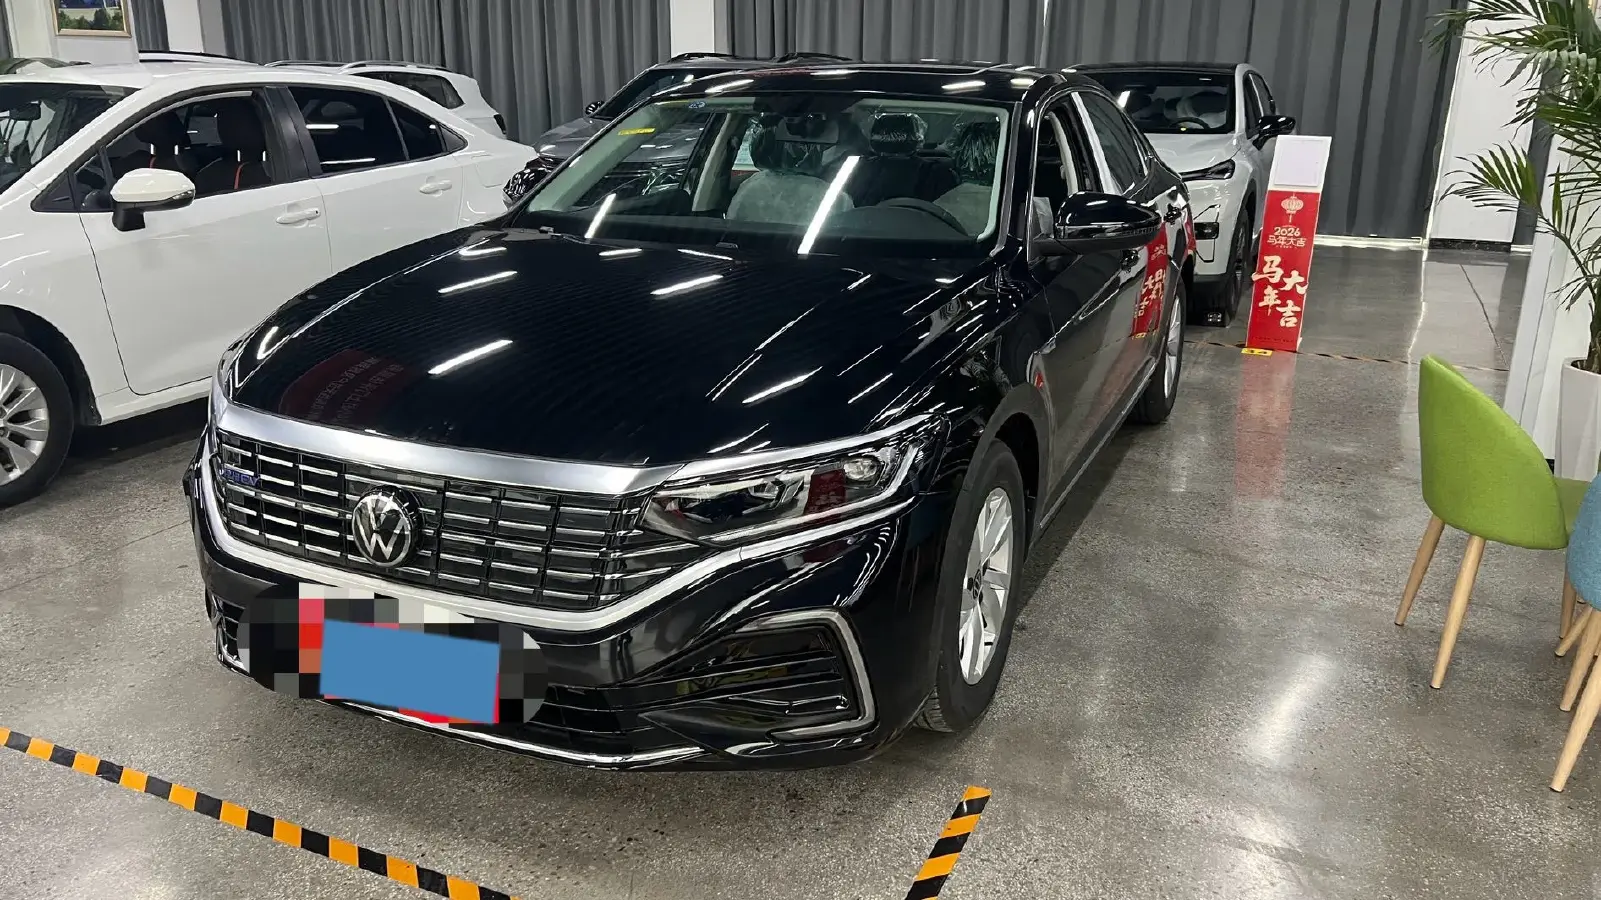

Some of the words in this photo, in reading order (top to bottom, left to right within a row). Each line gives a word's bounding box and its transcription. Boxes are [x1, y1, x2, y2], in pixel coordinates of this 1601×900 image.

[1274, 226, 1301, 237] 2026
[1267, 235, 1307, 248] 马年大吉
